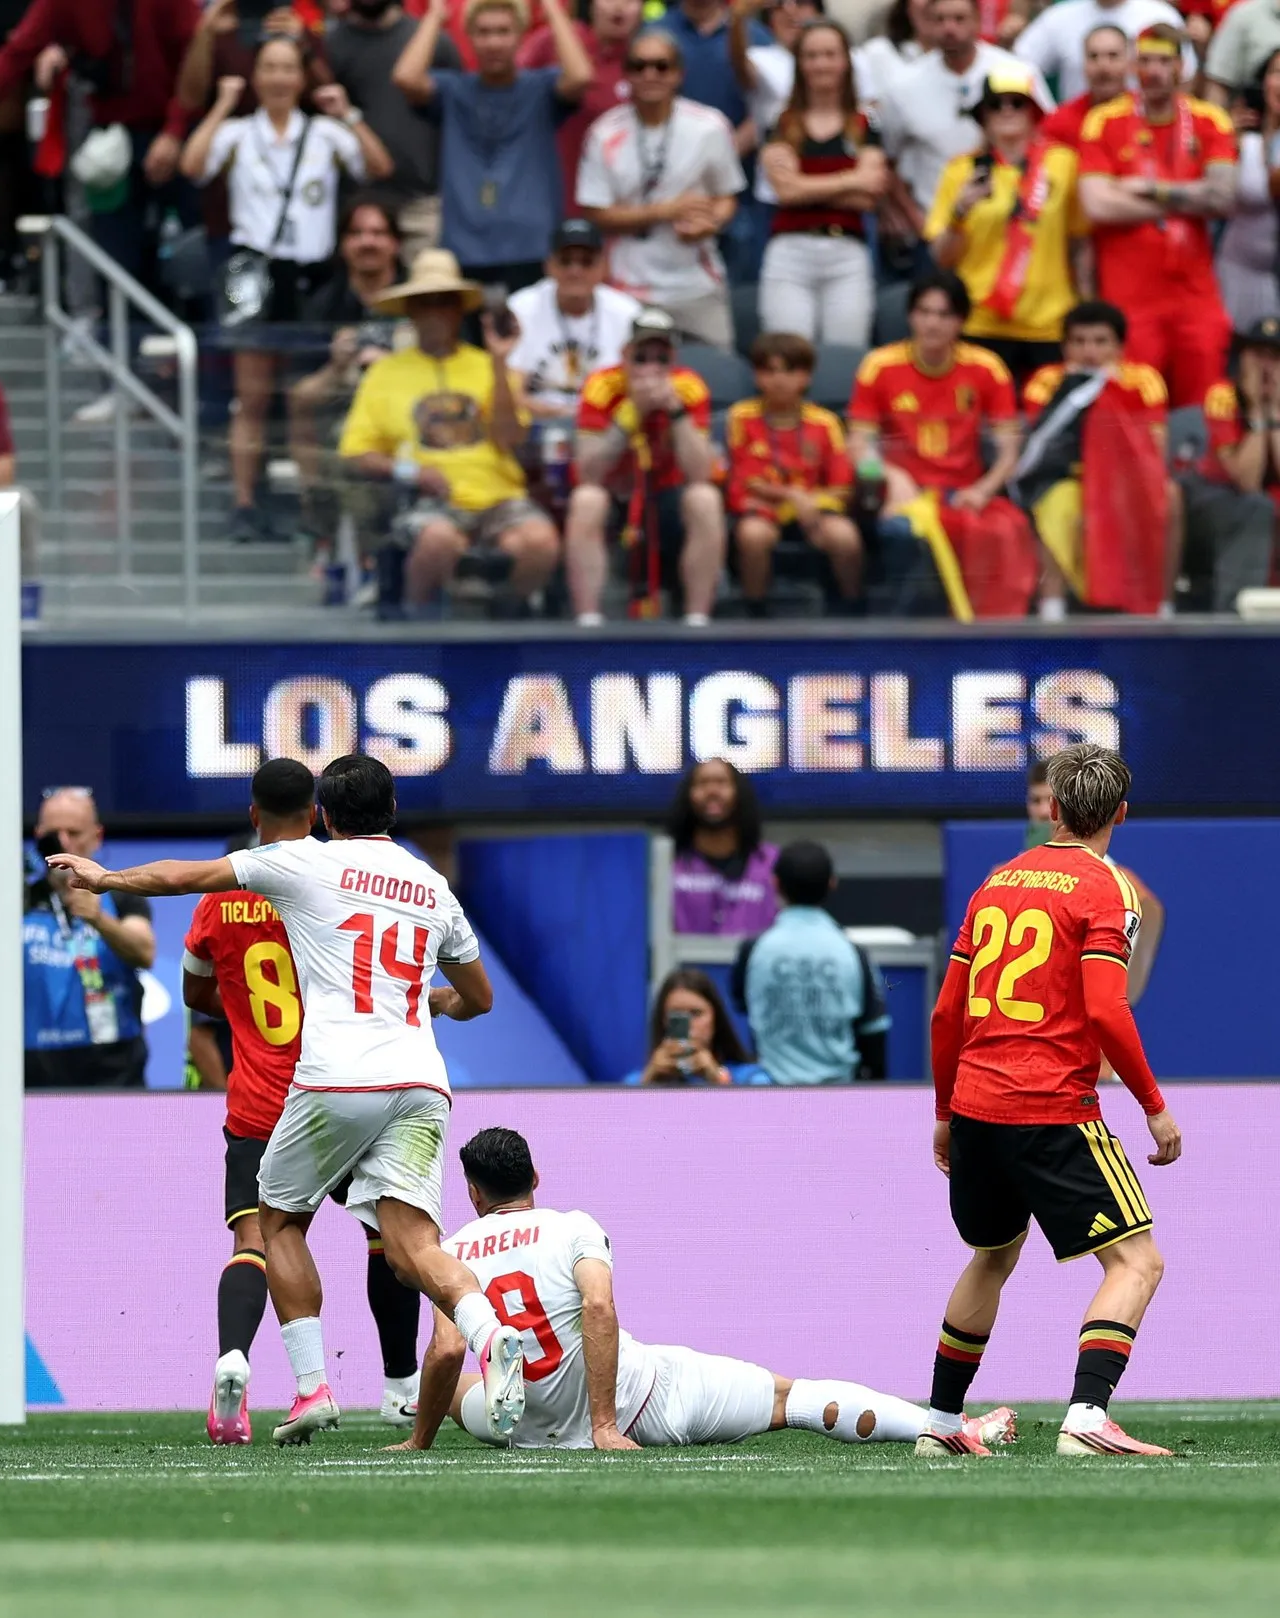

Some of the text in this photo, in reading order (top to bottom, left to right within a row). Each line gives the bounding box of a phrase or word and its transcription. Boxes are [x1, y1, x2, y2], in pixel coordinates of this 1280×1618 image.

[185, 669, 1121, 778] LOS ANGELES
[340, 868, 437, 909] GHODDOS
[244, 942, 300, 1045] 8
[335, 913, 429, 1027] 14
[968, 906, 1054, 1022] 22
[455, 1226, 540, 1260] TAREMI
[484, 1270, 564, 1382] 9
